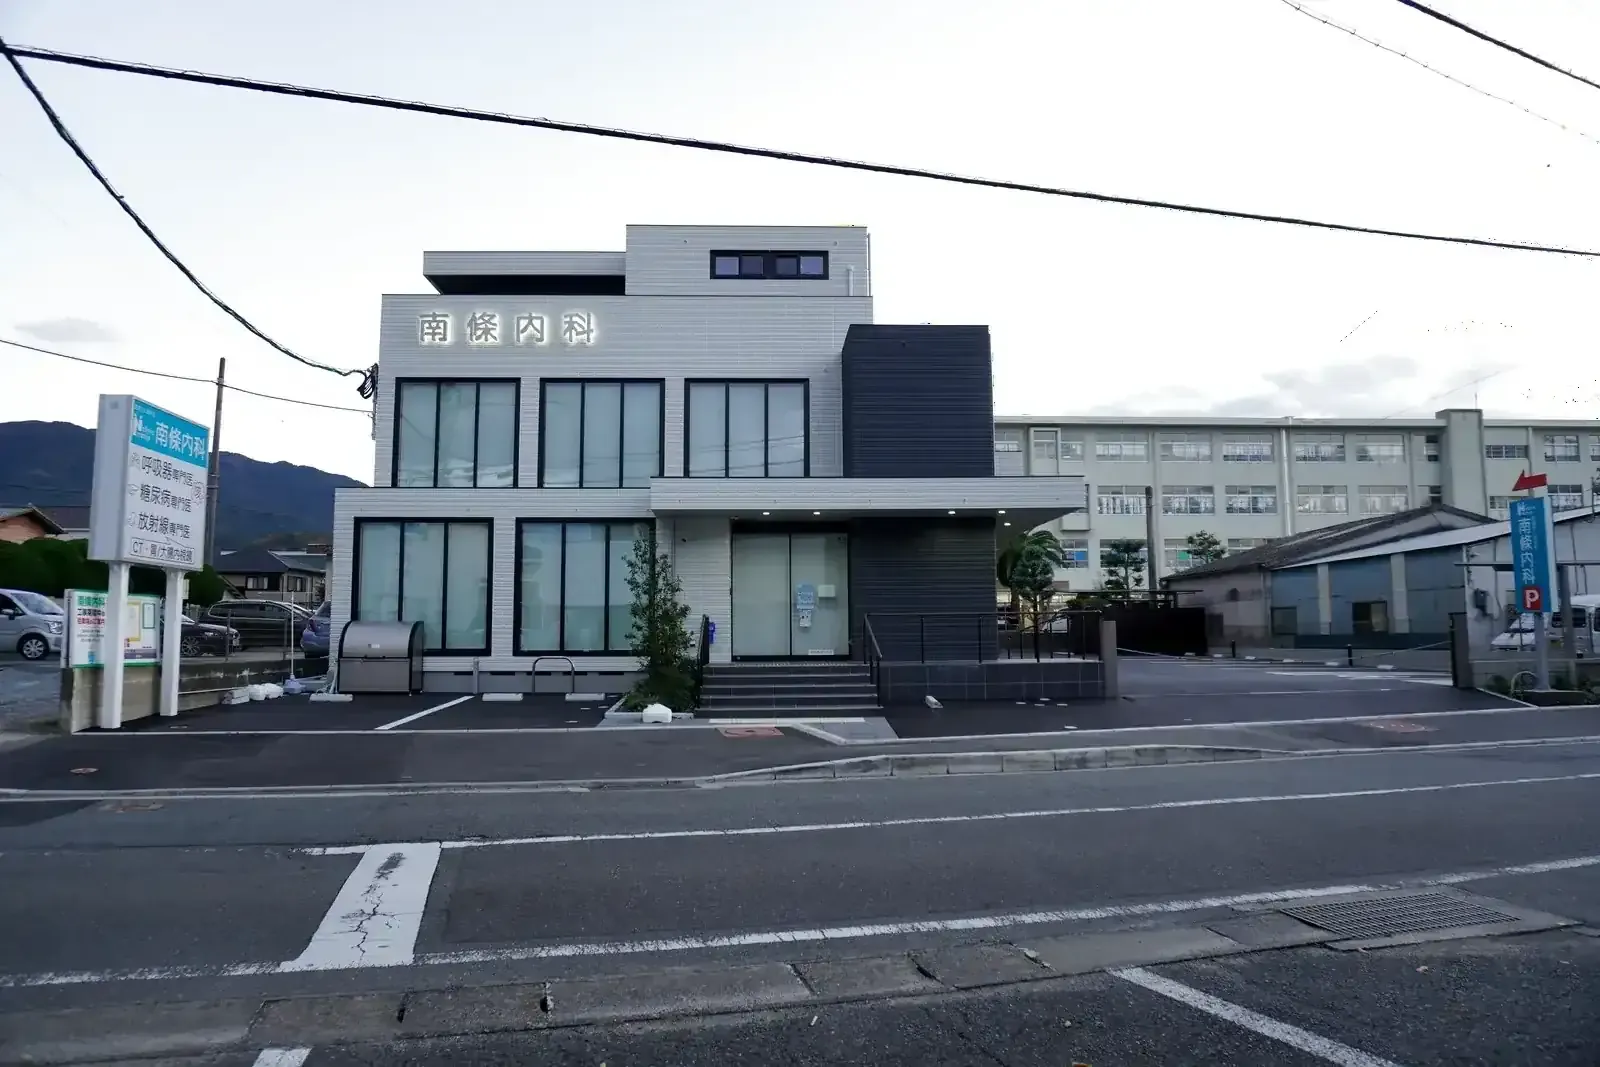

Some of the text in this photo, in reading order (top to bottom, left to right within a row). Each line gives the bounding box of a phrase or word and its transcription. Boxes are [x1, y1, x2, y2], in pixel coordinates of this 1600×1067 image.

[418, 312, 594, 343] 南條内科
[155, 421, 205, 460] 南條内科
[1518, 518, 1536, 585] 南條内科
[1524, 589, 1540, 609] P
